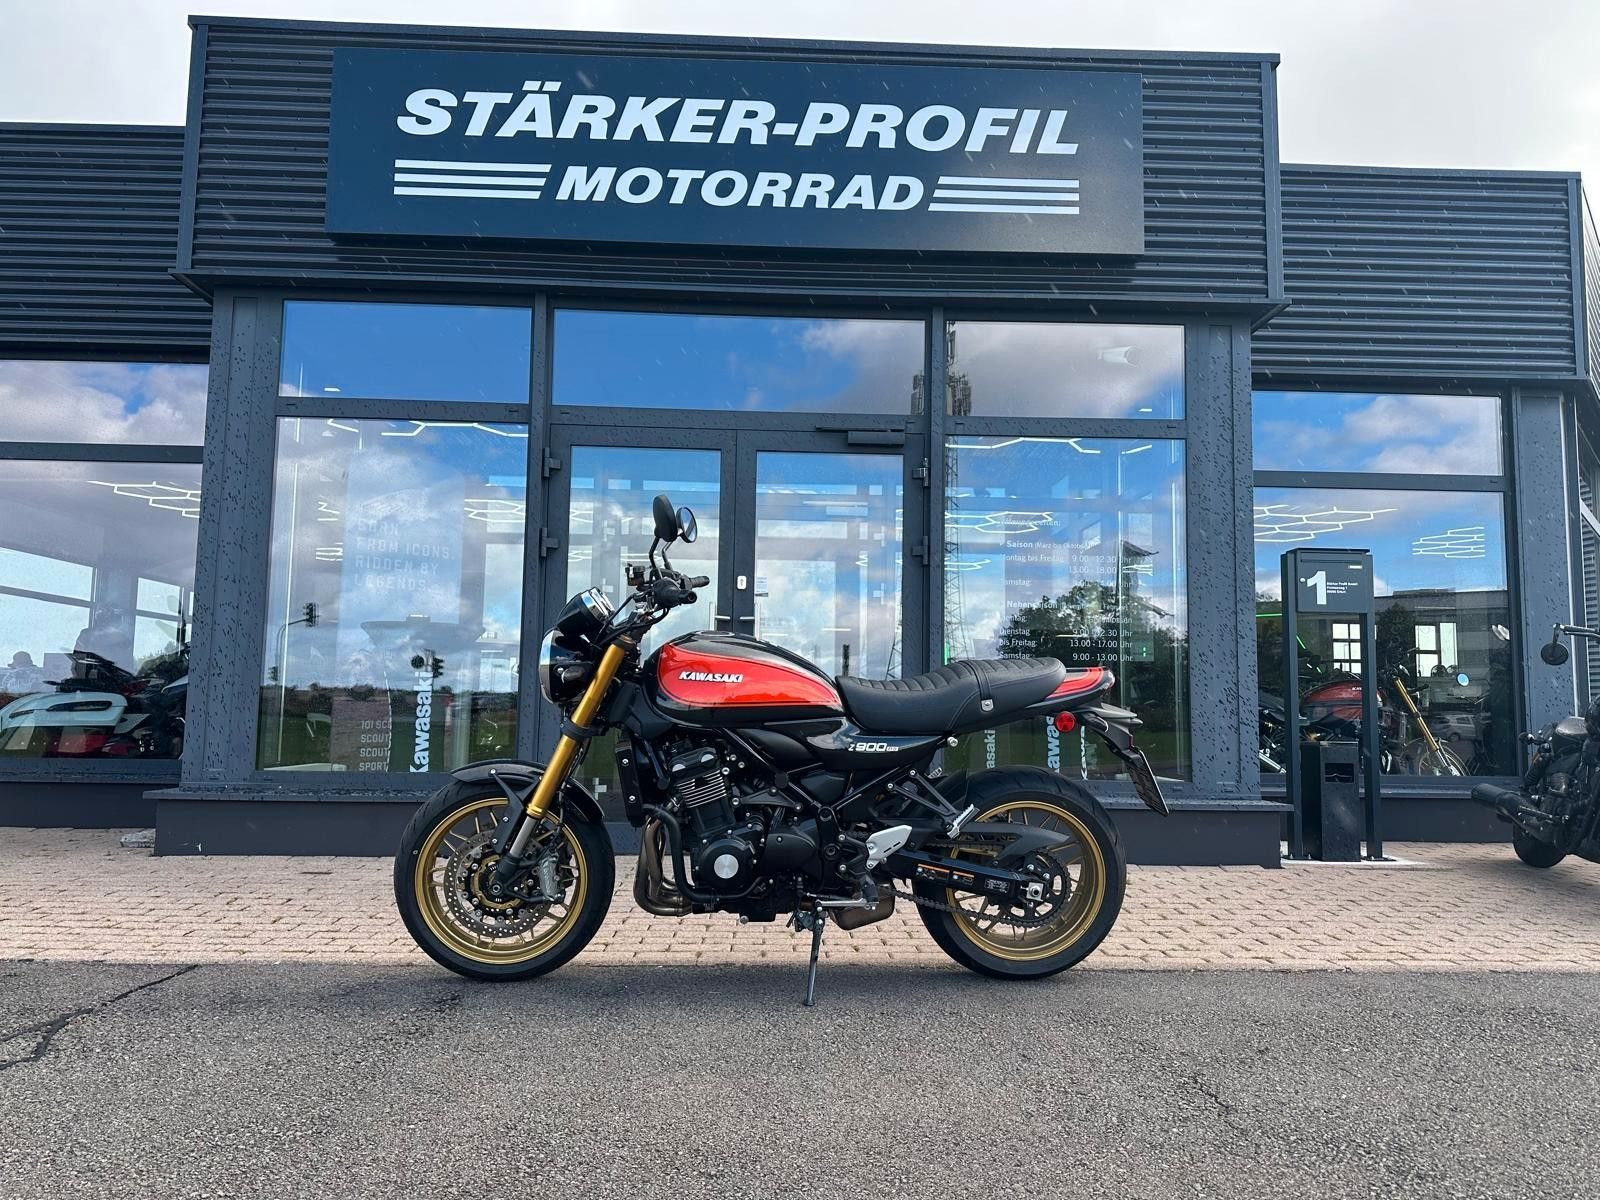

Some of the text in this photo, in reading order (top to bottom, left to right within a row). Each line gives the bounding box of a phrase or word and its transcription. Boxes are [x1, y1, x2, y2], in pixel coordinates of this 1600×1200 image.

[397, 81, 1079, 154] STÄRKER-PROFIL
[556, 166, 924, 211] MOTORRAD
[1006, 541, 1033, 549] Saison
[356, 555, 413, 573] RIDDEN
[1307, 571, 1327, 605] 1
[1070, 640, 1091, 648] 13.00
[1072, 653, 1090, 661] 9.00
[1097, 654, 1118, 662] 13.00
[678, 671, 744, 683] KAWASAKI
[410, 671, 434, 773] Kawasaki
[361, 734, 390, 744] SCOUT
[360, 748, 388, 757] SCOUT
[360, 763, 387, 772] SPORT
